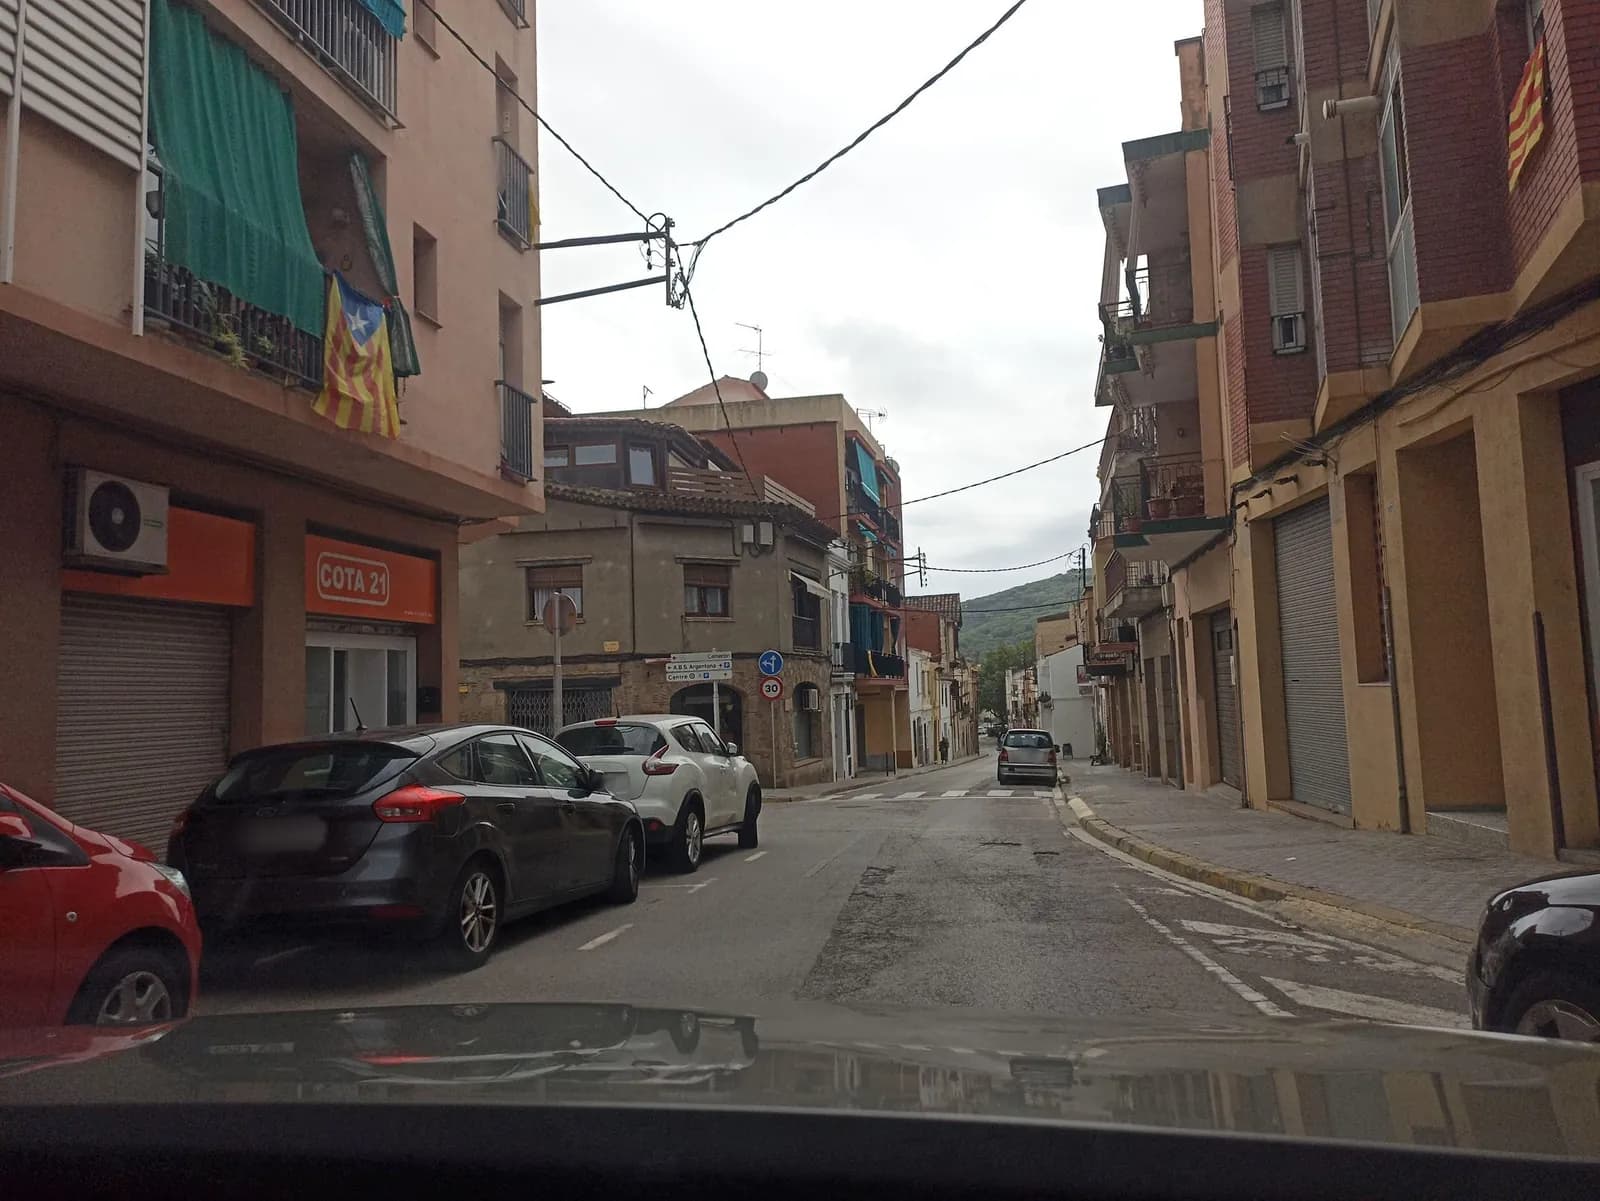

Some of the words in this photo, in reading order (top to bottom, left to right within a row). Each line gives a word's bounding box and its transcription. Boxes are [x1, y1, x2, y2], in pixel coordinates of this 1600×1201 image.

[320, 563, 365, 593] COTA
[369, 571, 386, 595] 21
[765, 684, 778, 693] 30
